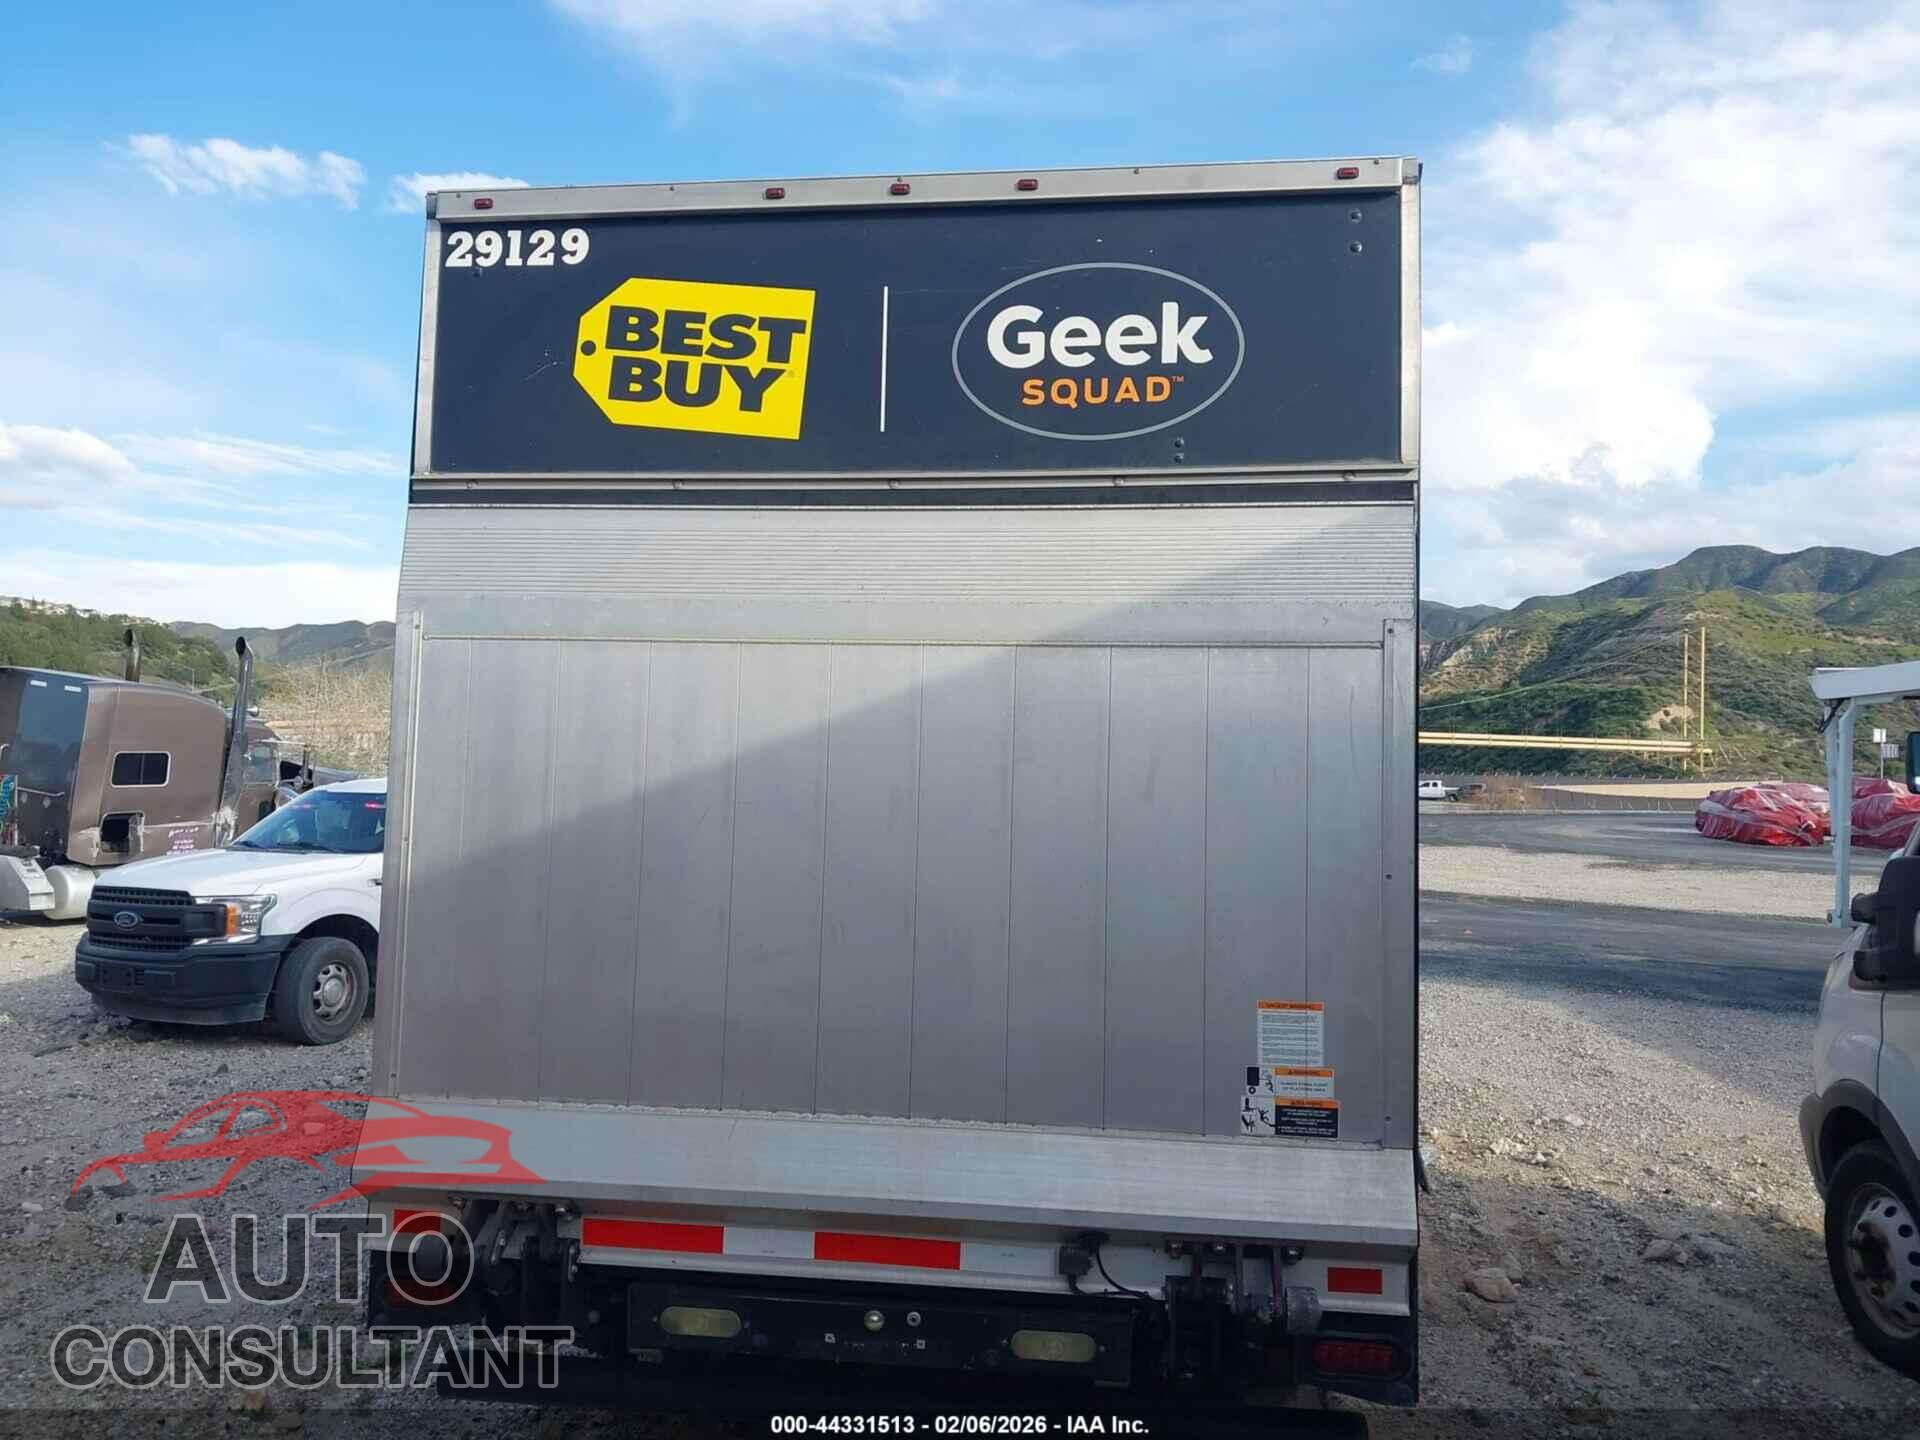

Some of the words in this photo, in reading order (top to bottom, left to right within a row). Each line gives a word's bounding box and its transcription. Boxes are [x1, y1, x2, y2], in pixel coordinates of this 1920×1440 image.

[445, 228, 591, 268] 29129
[605, 305, 807, 364] BEST
[986, 301, 1214, 369] Geek
[607, 355, 787, 413] BUY
